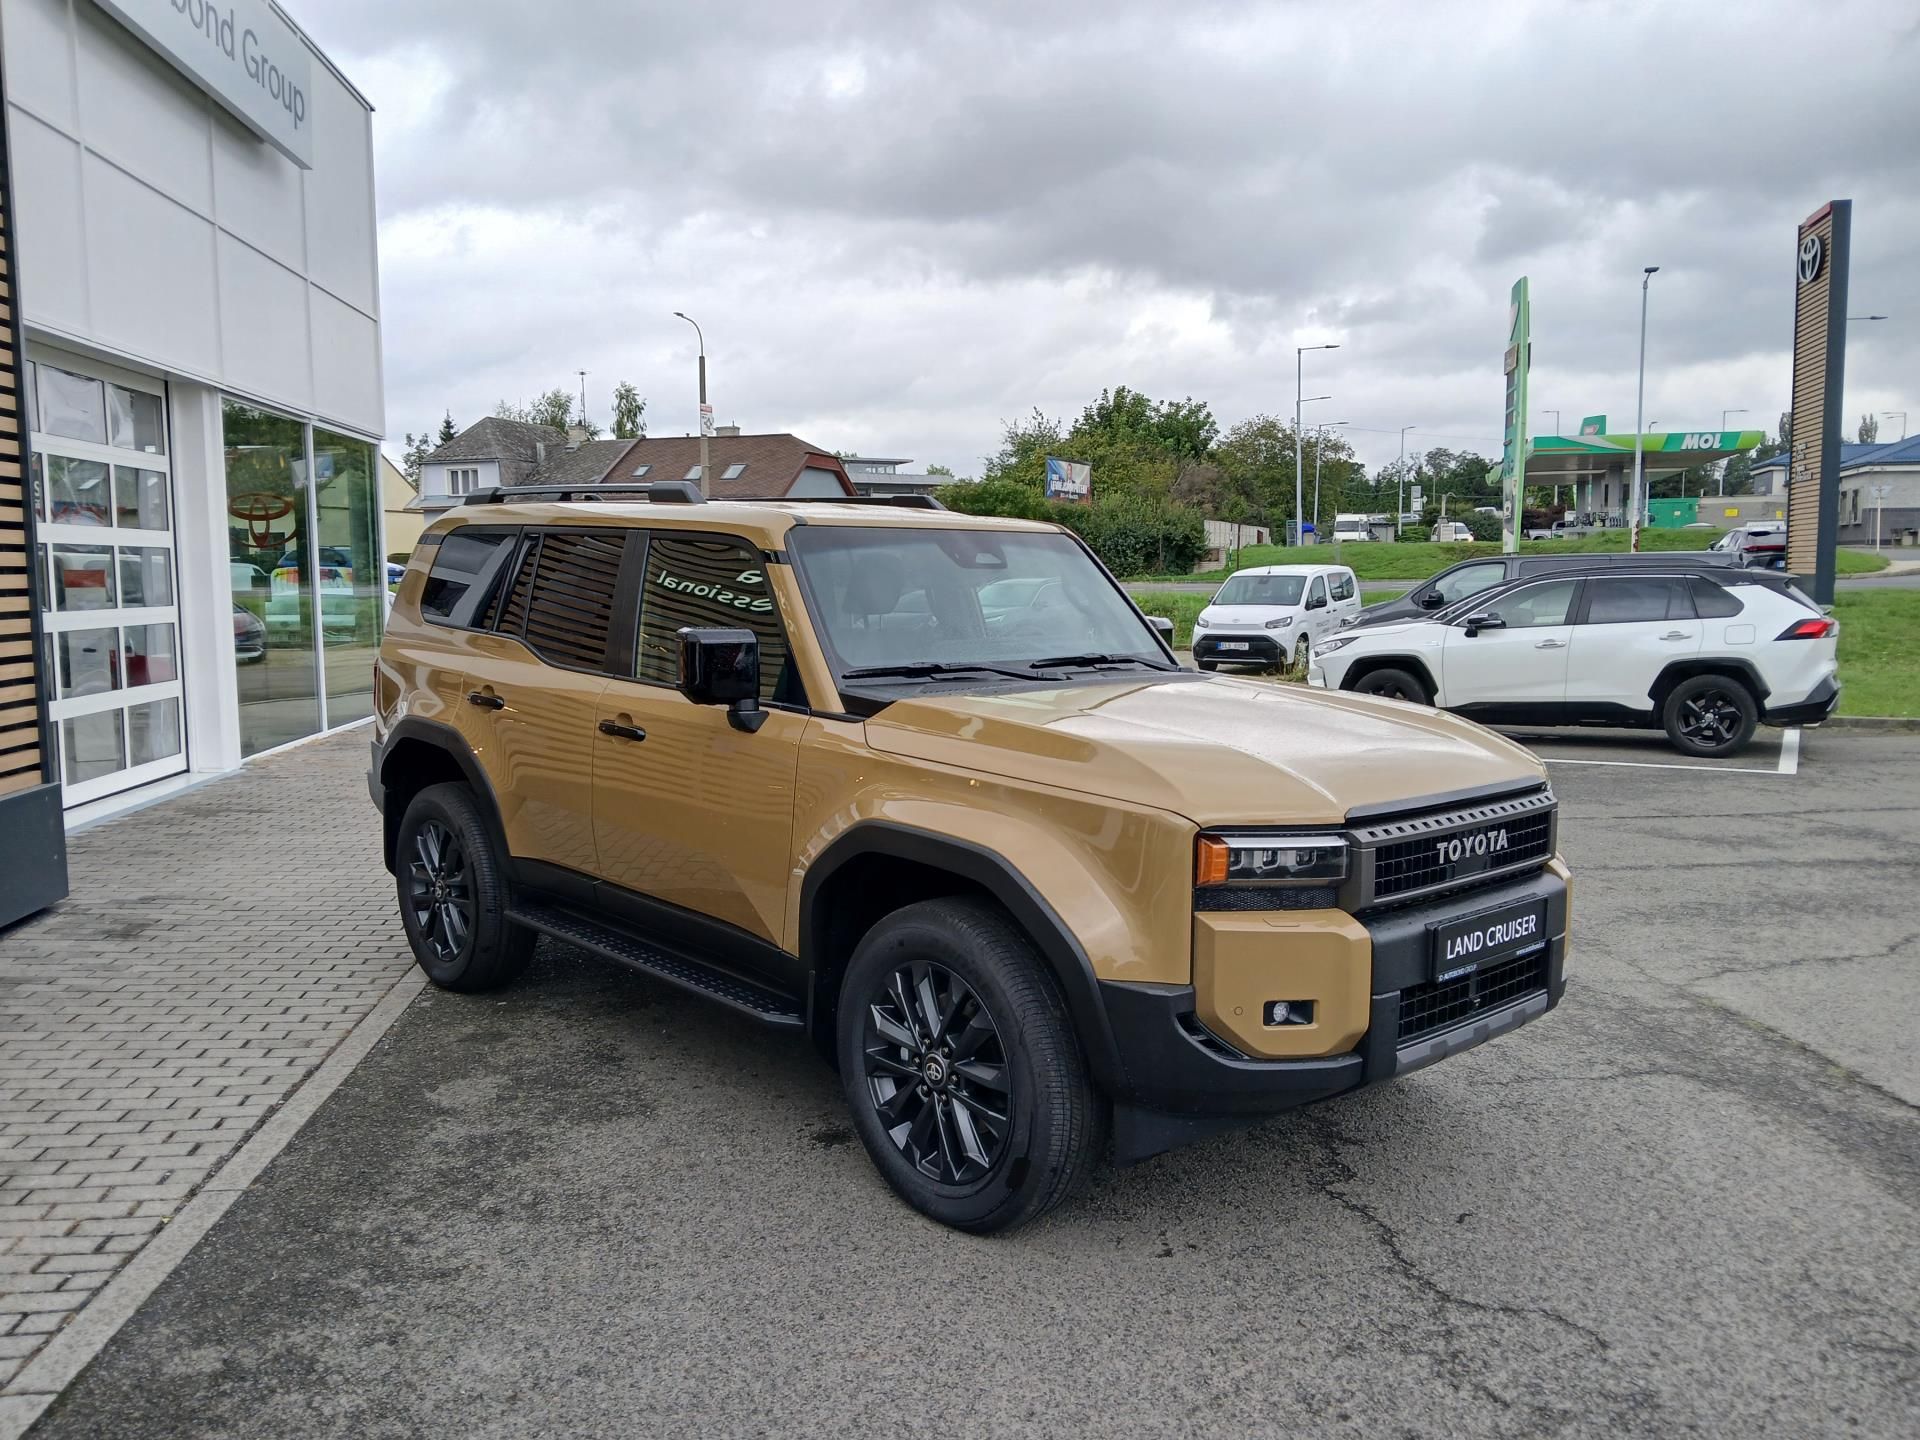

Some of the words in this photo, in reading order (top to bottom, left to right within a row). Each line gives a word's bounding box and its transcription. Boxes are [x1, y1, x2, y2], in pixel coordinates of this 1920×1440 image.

[243, 28, 305, 130] Group
[1680, 433, 1722, 450] MOL
[1436, 828, 1508, 864] TOYOTA
[1446, 931, 1484, 960] LAND
[1486, 914, 1537, 947] CRUISER
